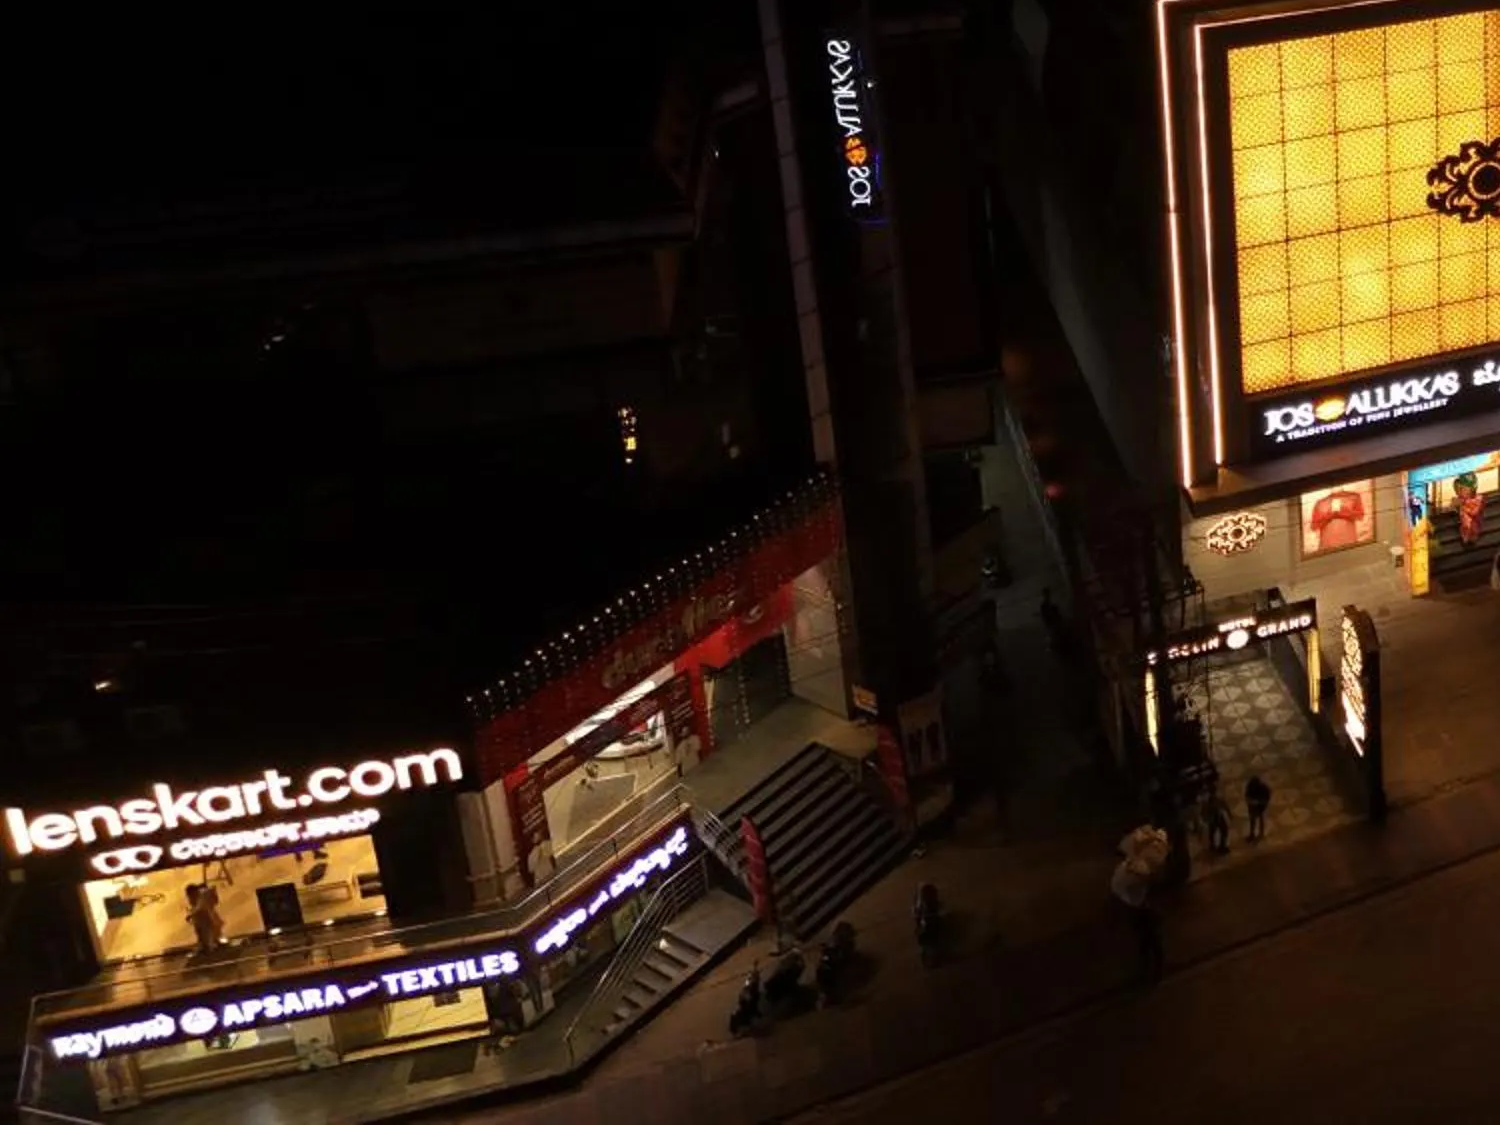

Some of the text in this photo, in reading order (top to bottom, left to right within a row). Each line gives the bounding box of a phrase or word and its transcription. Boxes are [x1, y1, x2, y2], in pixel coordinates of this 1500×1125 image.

[1263, 403, 1315, 436] JOS
[1345, 372, 1460, 415] ALUKKAS
[1275, 435, 1285, 444] A
[1287, 421, 1347, 441] TRADITION
[1349, 417, 1364, 426] OF
[1256, 614, 1312, 638] GRAND
[4, 747, 463, 856] lenskart.com
[222, 984, 347, 1028] APSARA
[381, 950, 520, 997] TEXTILES
